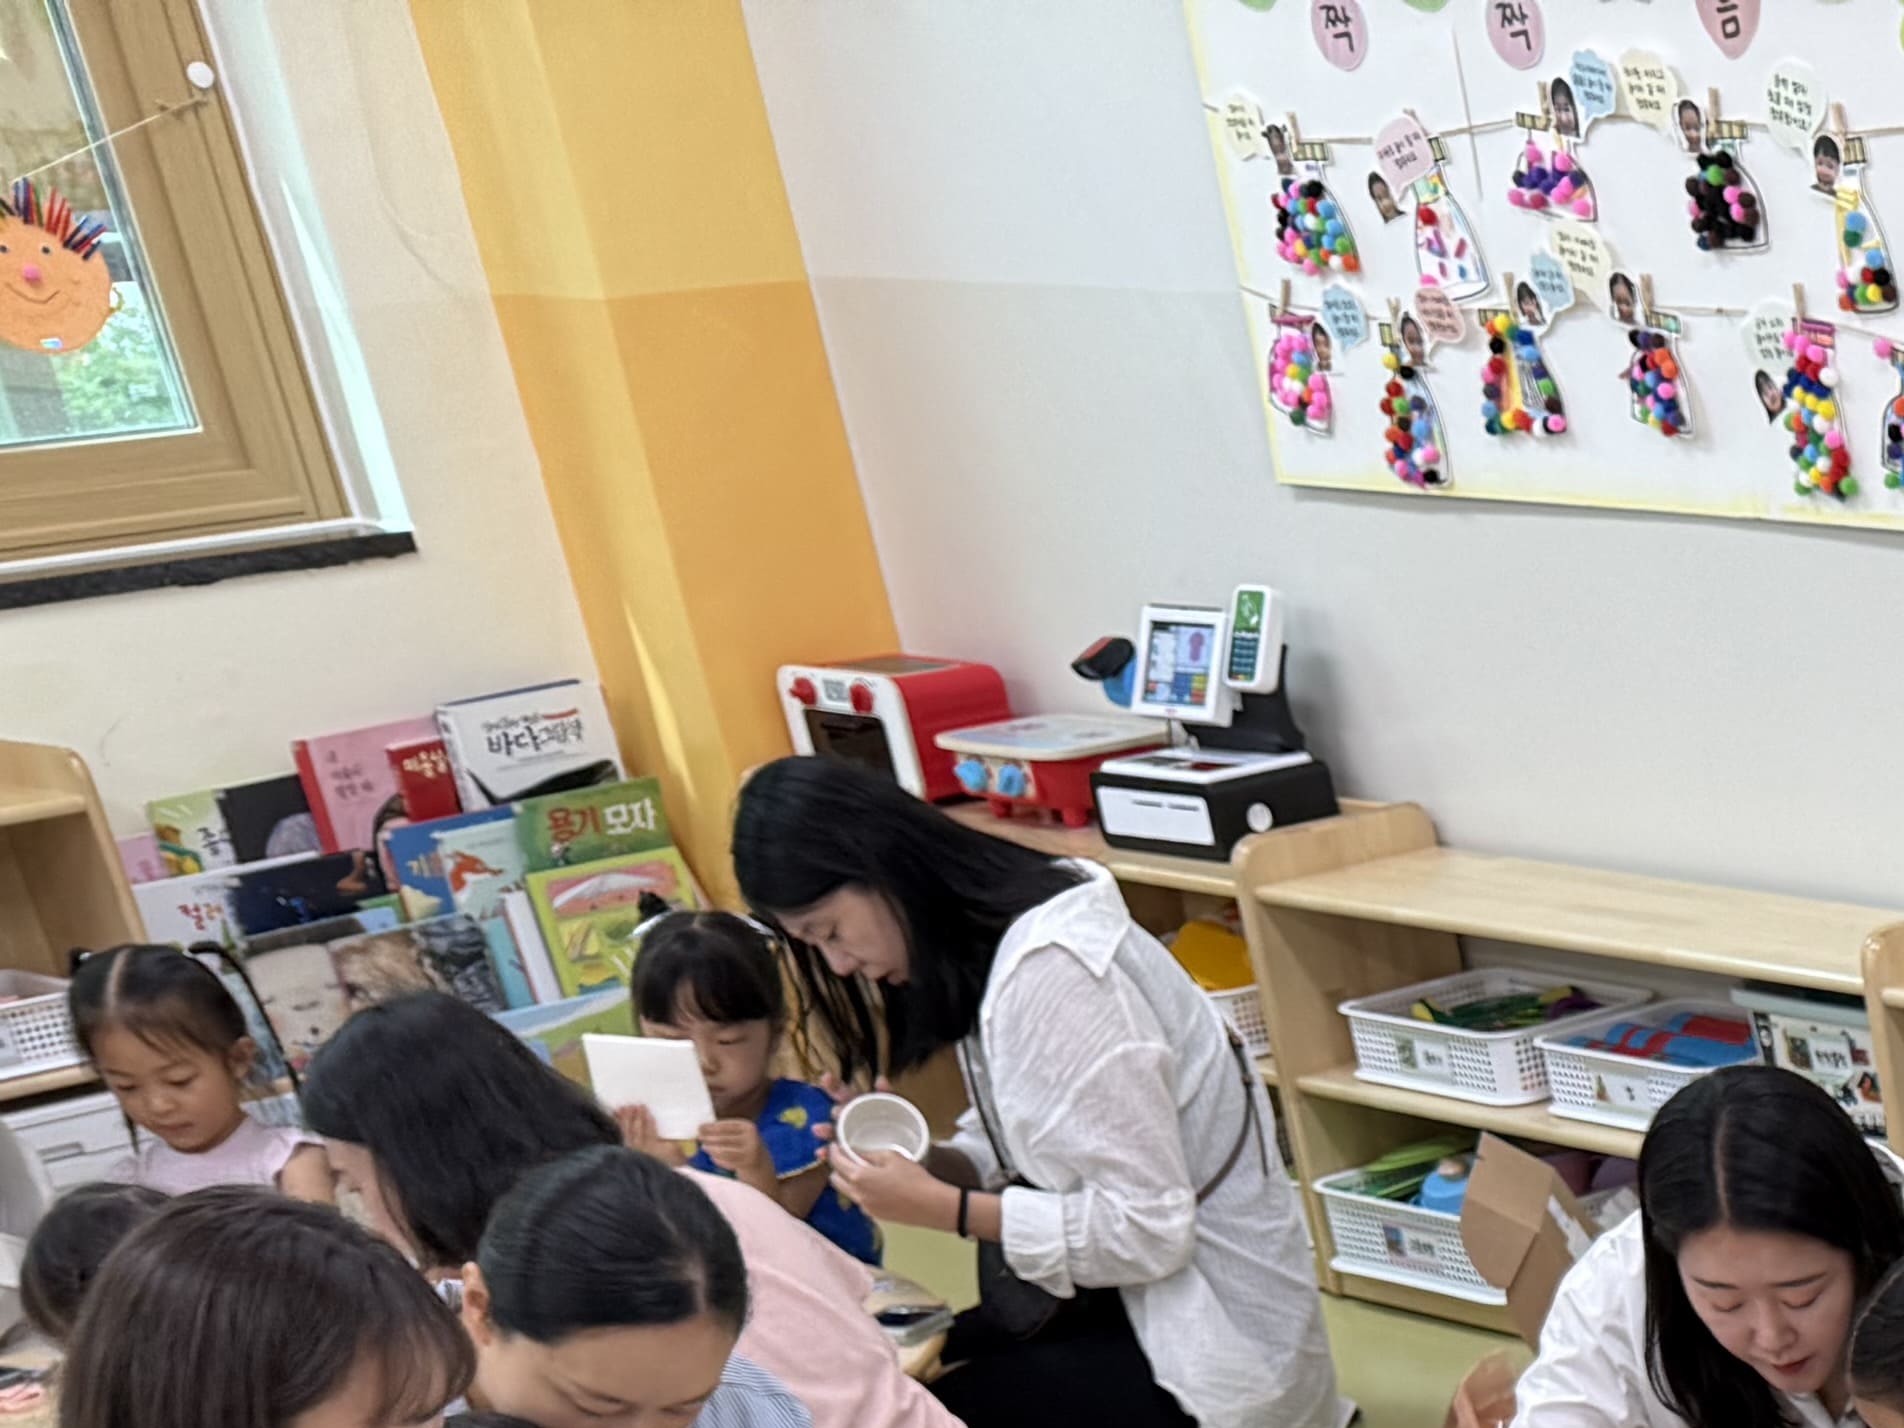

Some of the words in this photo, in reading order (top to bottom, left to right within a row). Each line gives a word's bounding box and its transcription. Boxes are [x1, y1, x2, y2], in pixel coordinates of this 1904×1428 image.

[1319, 4, 1354, 52] 짝
[1496, 2, 1531, 50] 짝
[603, 797, 657, 836] 모자
